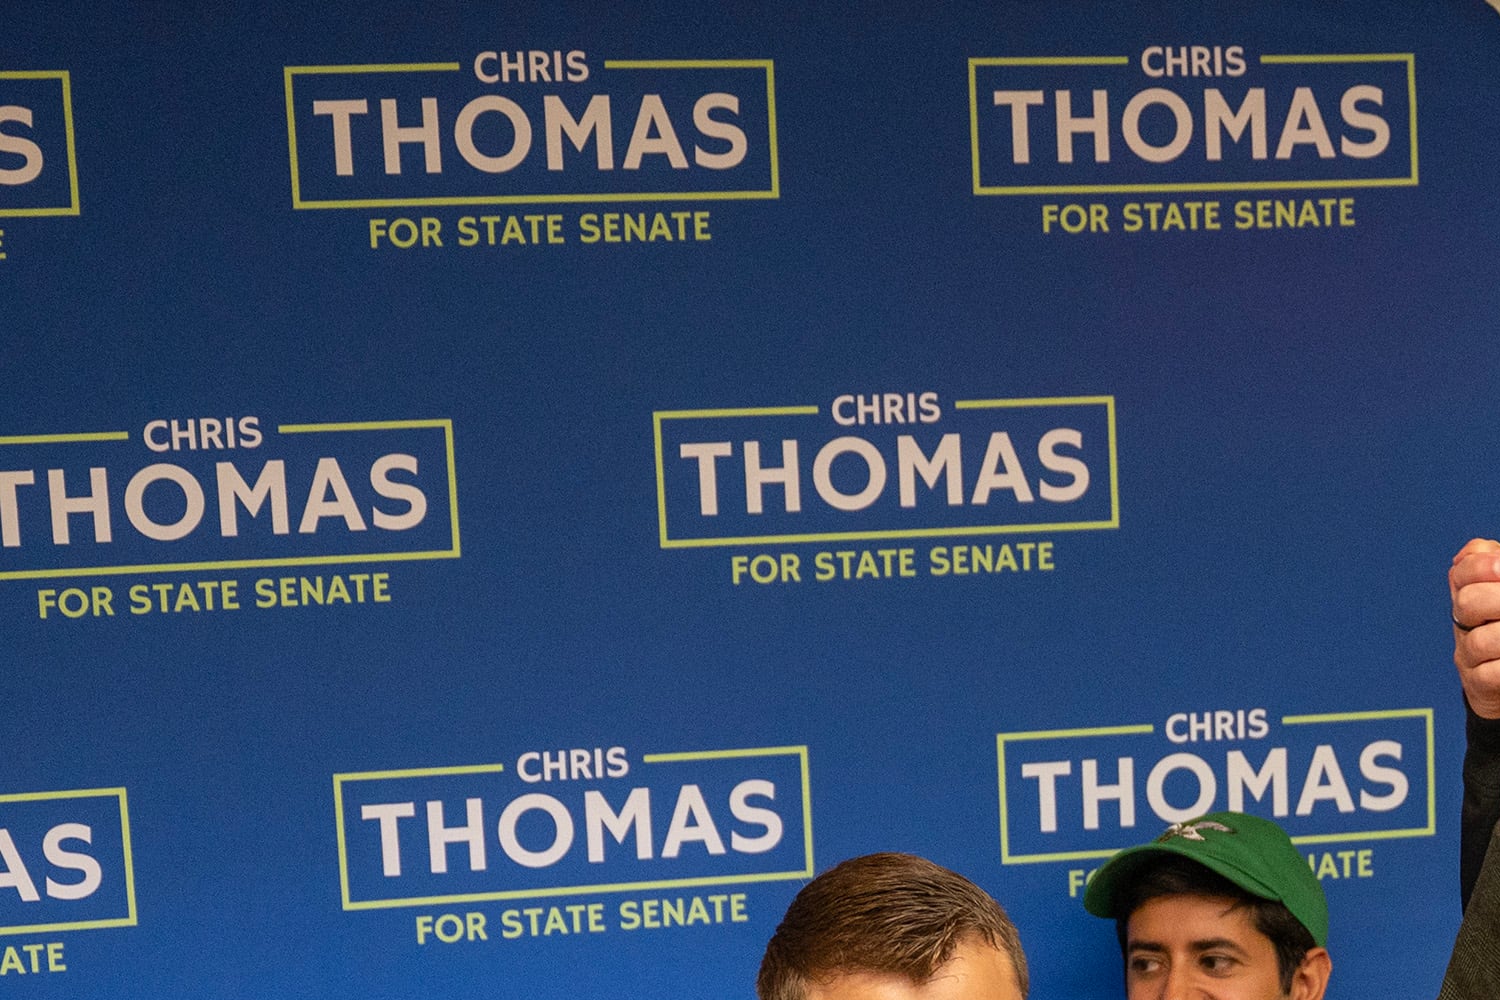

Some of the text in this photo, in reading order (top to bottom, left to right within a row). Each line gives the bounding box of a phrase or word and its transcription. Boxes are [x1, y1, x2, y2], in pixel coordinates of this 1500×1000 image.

[473, 49, 590, 84] CHRIS
[1140, 45, 1247, 78] CHRIS
[312, 92, 748, 176] THOMAS
[993, 84, 1391, 164] THOMAS
[369, 211, 712, 249] FOR STATE SENATE
[1042, 197, 1356, 234] FOR STATE SENATE
[831, 391, 942, 427] CHRIS
[143, 415, 263, 453] CHRIS
[679, 427, 1091, 517] THOMAS
[0, 453, 428, 548] THOMAS
[731, 541, 1055, 585] FOR STATE SENATE
[37, 572, 392, 619] FOR STATE SENATE
[1164, 707, 1270, 745] CHRIS
[516, 745, 630, 784] CHRIS
[1021, 739, 1410, 833] THOMAS
[360, 778, 784, 878] THOMAS
[1308, 849, 1374, 881] ATE
[415, 893, 749, 945] FOR STATE SENATE
[0, 942, 67, 976] ATE
